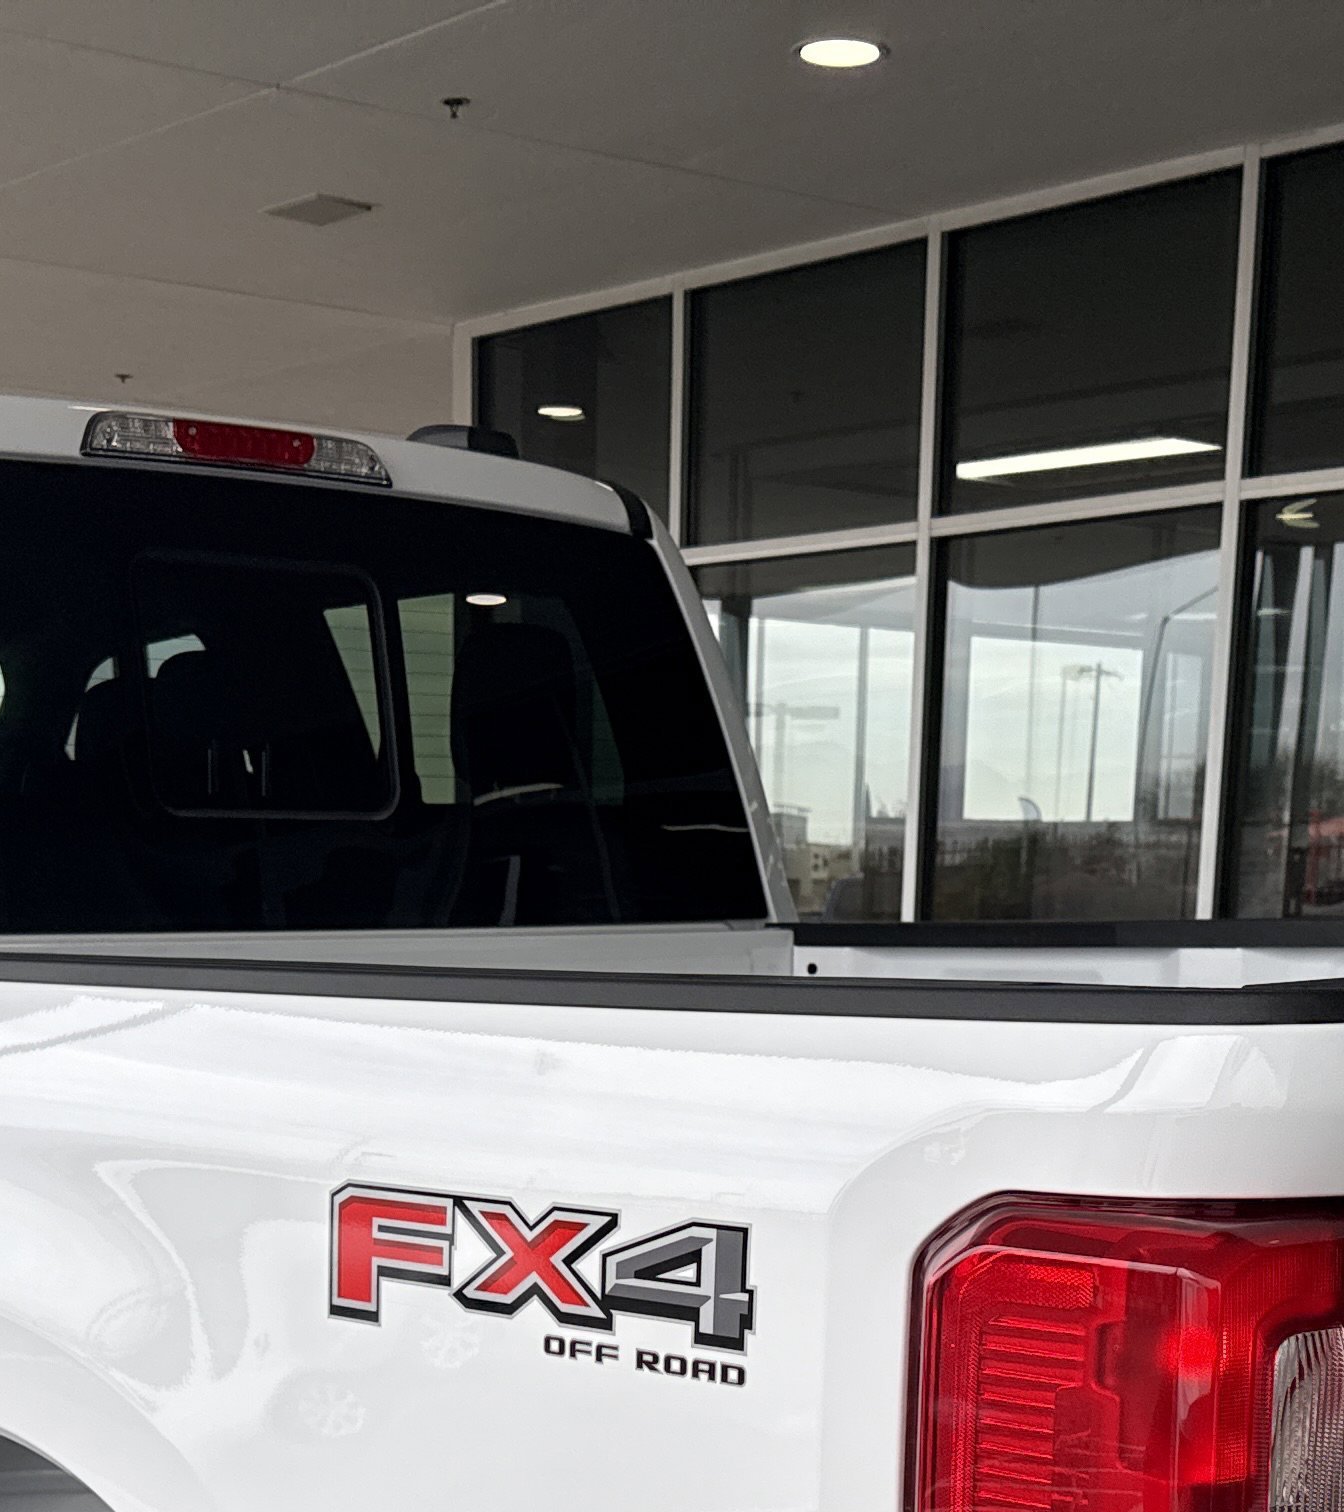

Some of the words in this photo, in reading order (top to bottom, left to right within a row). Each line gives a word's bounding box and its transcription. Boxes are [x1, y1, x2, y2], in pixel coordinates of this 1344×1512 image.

[328, 1179, 757, 1355] FX4
[543, 1334, 620, 1364] OFF
[635, 1347, 746, 1387] ROAD
